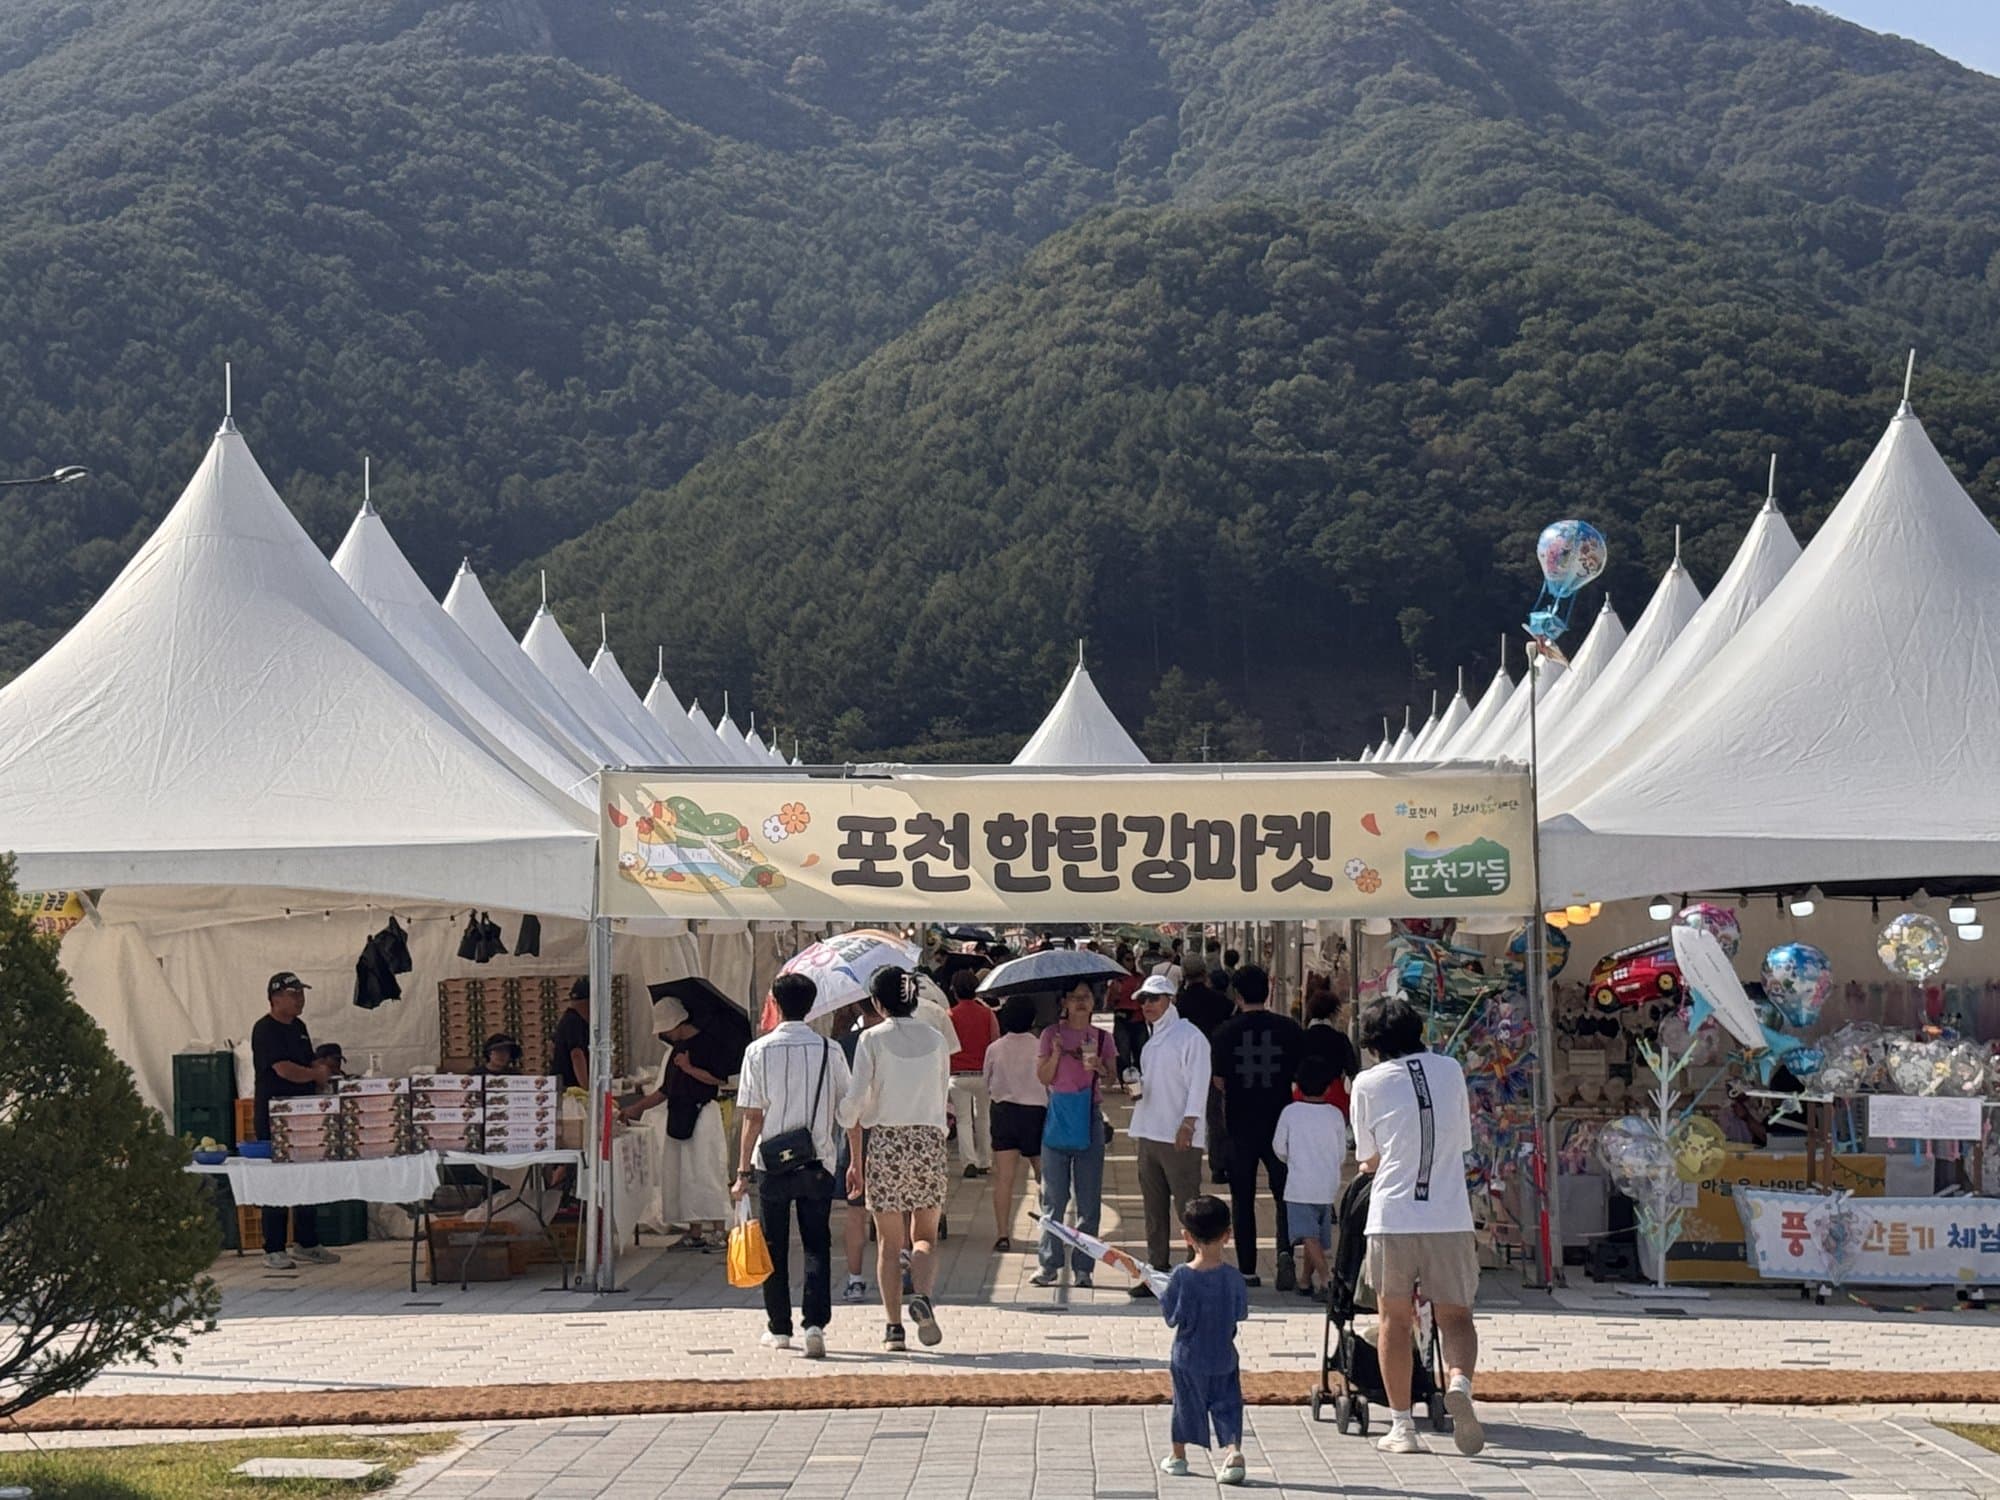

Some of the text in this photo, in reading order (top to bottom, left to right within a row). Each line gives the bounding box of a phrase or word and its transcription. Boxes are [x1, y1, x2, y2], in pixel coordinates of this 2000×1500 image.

[831, 811, 1333, 893] 포천 한탄강마켓
[1409, 859, 1507, 893] 포천가득
[1947, 1222, 2000, 1253] 체험
